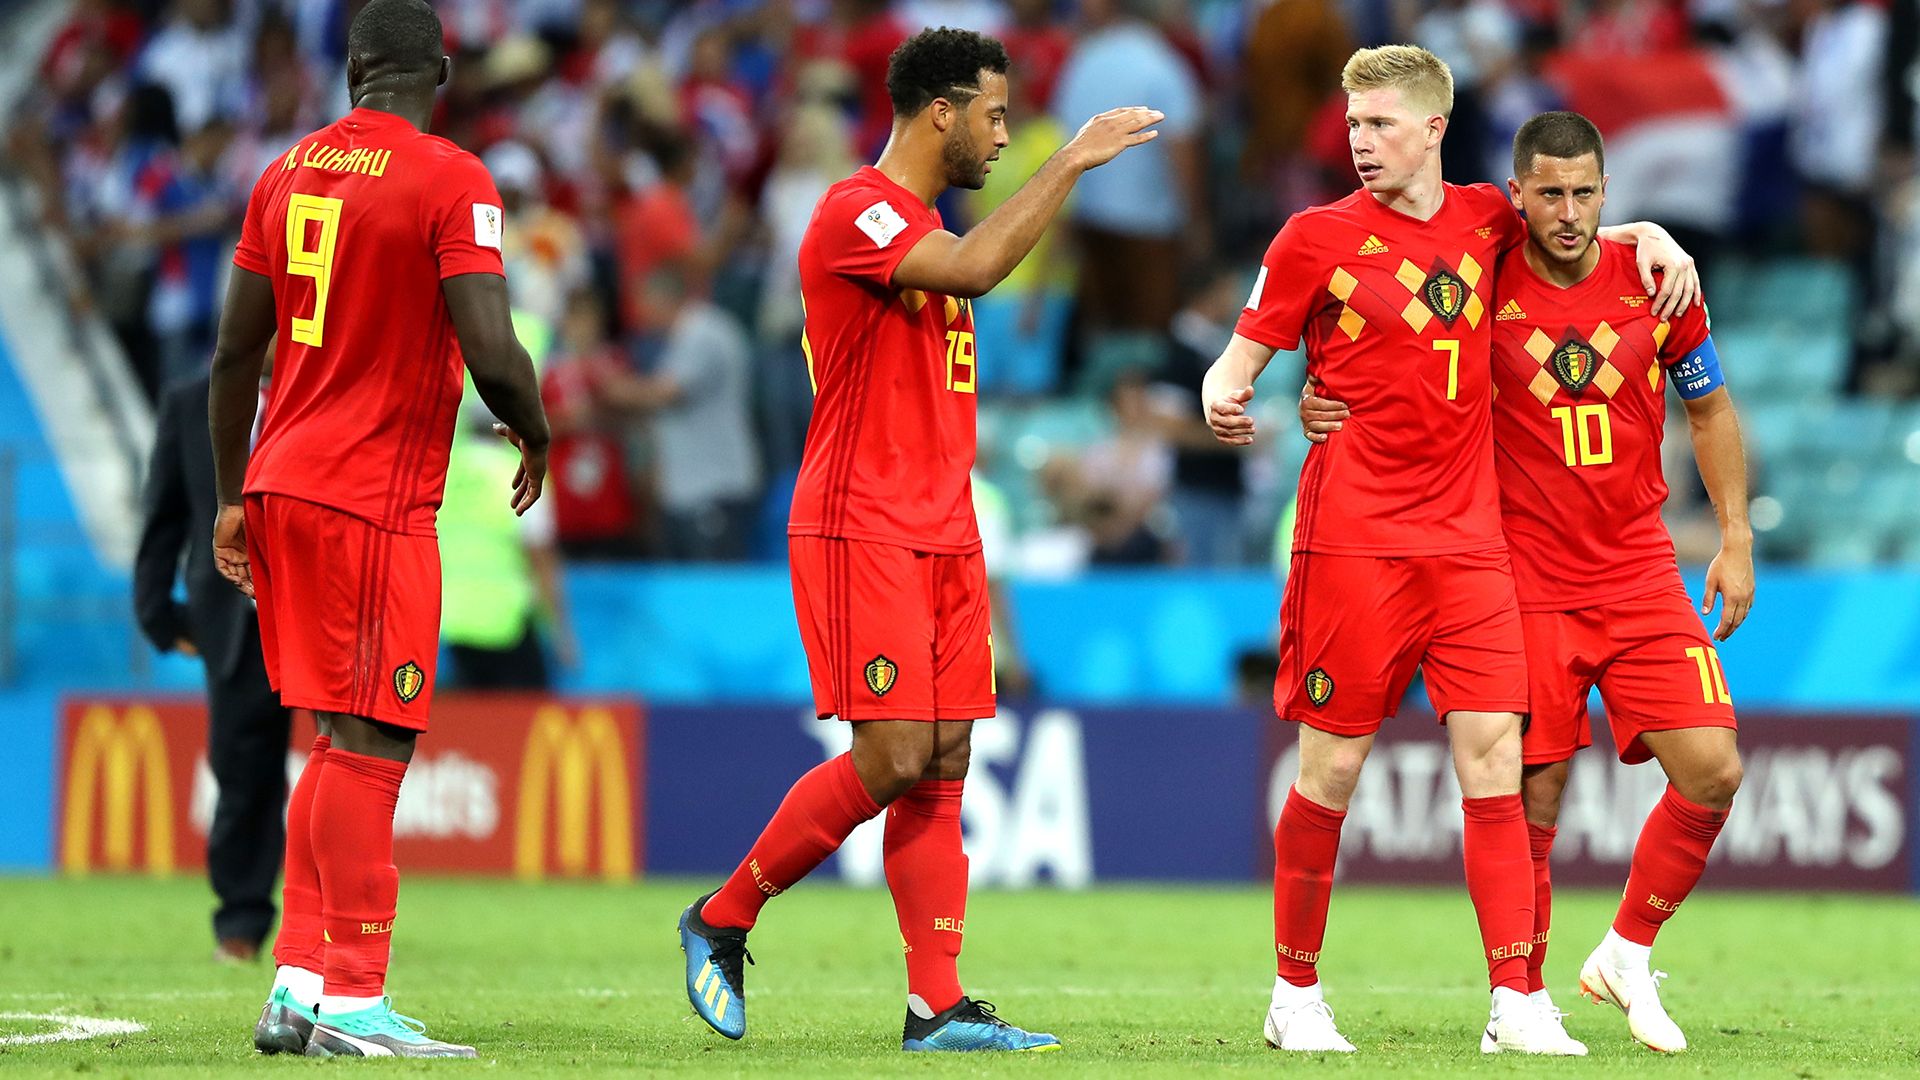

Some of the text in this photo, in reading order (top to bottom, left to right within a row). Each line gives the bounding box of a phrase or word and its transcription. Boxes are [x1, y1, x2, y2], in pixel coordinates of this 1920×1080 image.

[1357, 244, 1389, 256] adidas
[286, 192, 344, 347] 9
[1495, 310, 1527, 322] adidas
[945, 329, 976, 394] 19
[1432, 339, 1460, 400] 7
[1673, 364, 1705, 378] BALL
[1687, 375, 1711, 391] FIFA
[1551, 404, 1613, 466] 10
[1646, 893, 1681, 912] BELG
[361, 920, 393, 935] BELG
[934, 917, 965, 935] BELG
[1277, 942, 1320, 963] BELGIU
[1491, 941, 1534, 961] BELGIU
